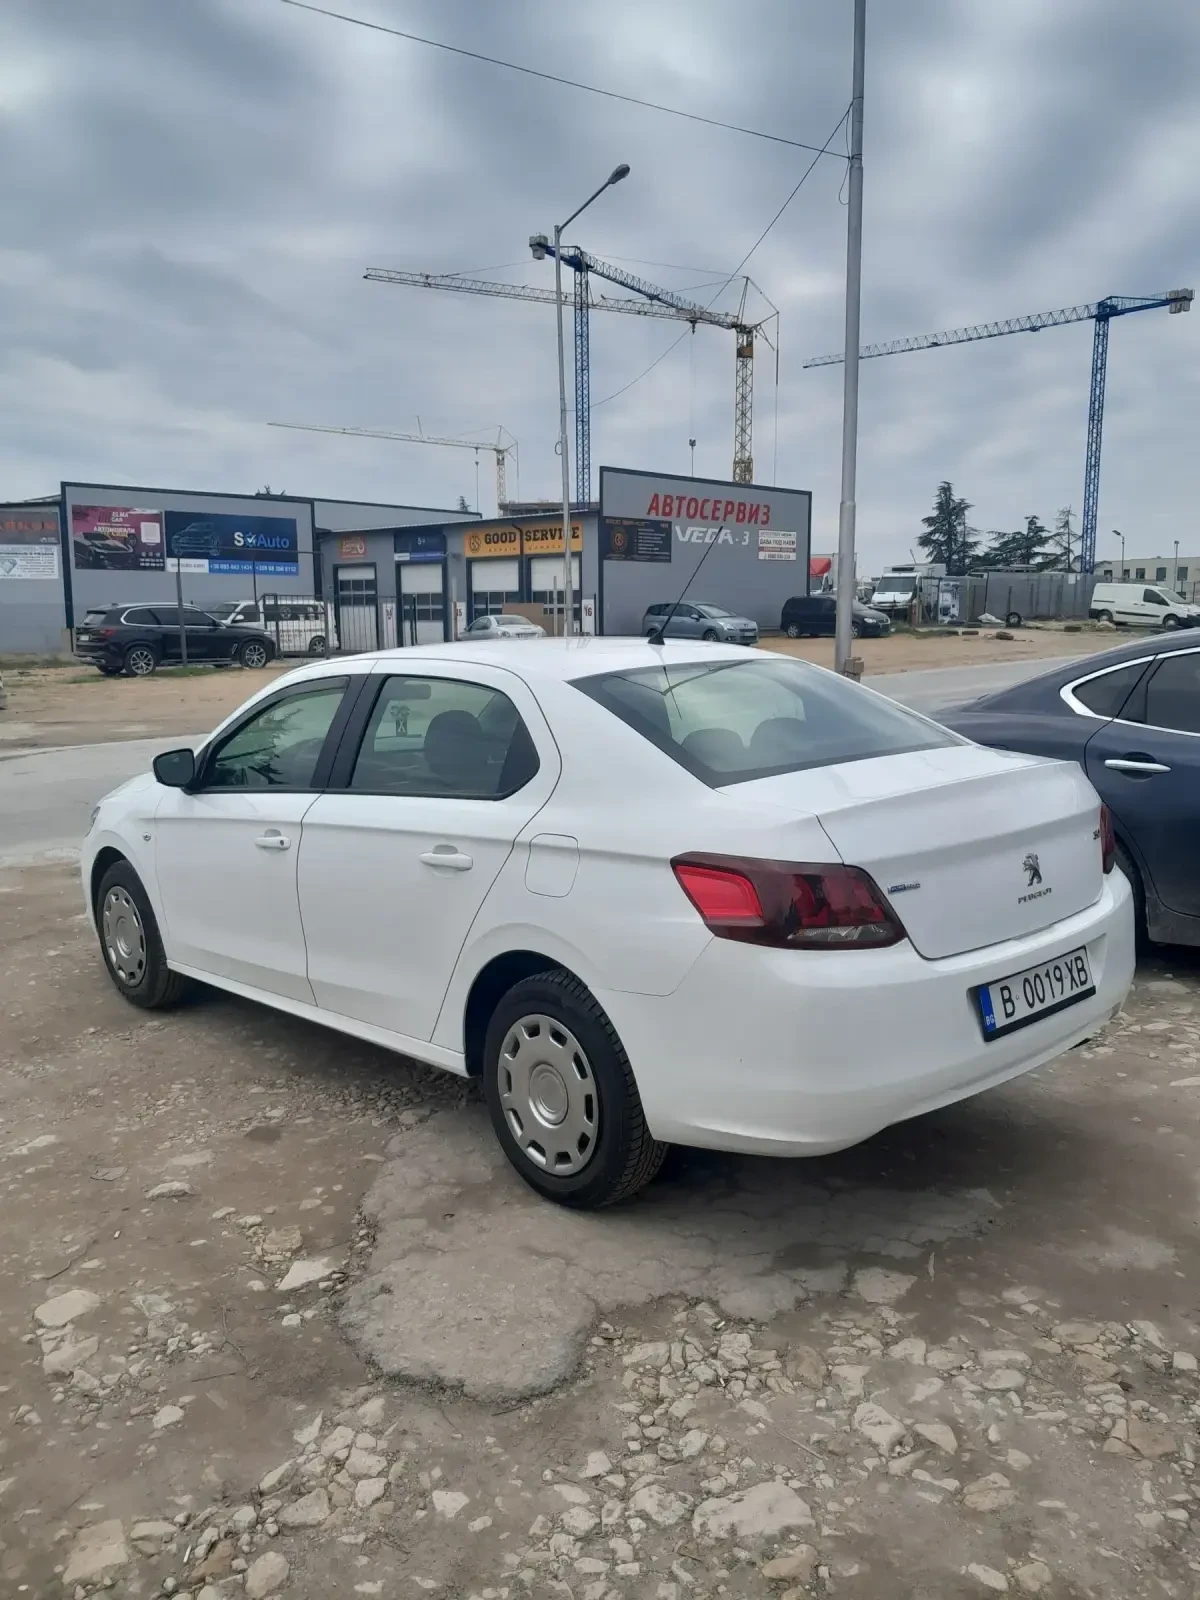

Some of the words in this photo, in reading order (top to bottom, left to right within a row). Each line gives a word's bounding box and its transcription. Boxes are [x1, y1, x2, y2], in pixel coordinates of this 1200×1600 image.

[646, 493, 771, 525] АВТОСЕРВИЗ
[257, 534, 290, 549] Auto
[484, 531, 517, 545] GOOD
[524, 526, 580, 542] SERVIE
[583, 605, 593, 617] 16
[999, 984, 1016, 1020] B
[1022, 964, 1064, 1010] 0019
[1064, 955, 1089, 991] XB
[985, 1013, 995, 1026] BG
